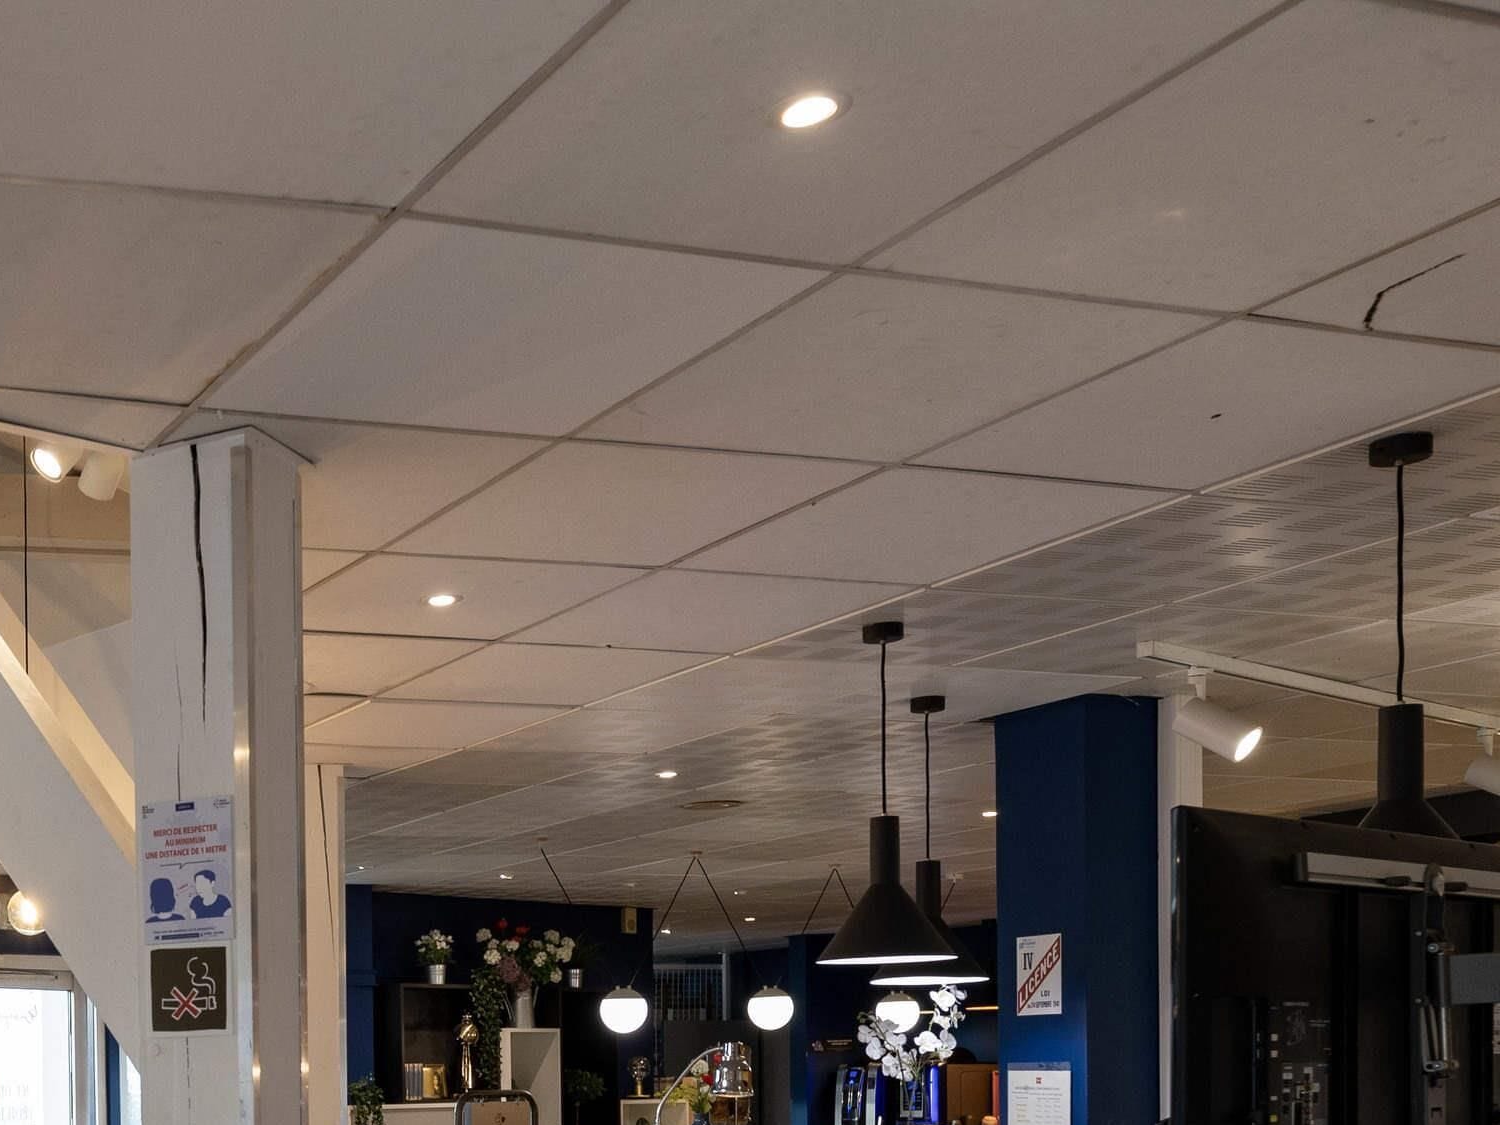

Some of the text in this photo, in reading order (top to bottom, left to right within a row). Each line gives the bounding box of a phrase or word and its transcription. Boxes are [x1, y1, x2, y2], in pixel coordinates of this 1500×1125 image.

[153, 823, 217, 837] MERCI DE RESPECTER
[165, 838, 174, 848] AU
[145, 850, 158, 860] UNE
[160, 849, 189, 858] DISTANCE
[191, 847, 199, 856] DE
[1023, 952, 1033, 970] IV
[1019, 940, 1060, 1009] LICENCE
